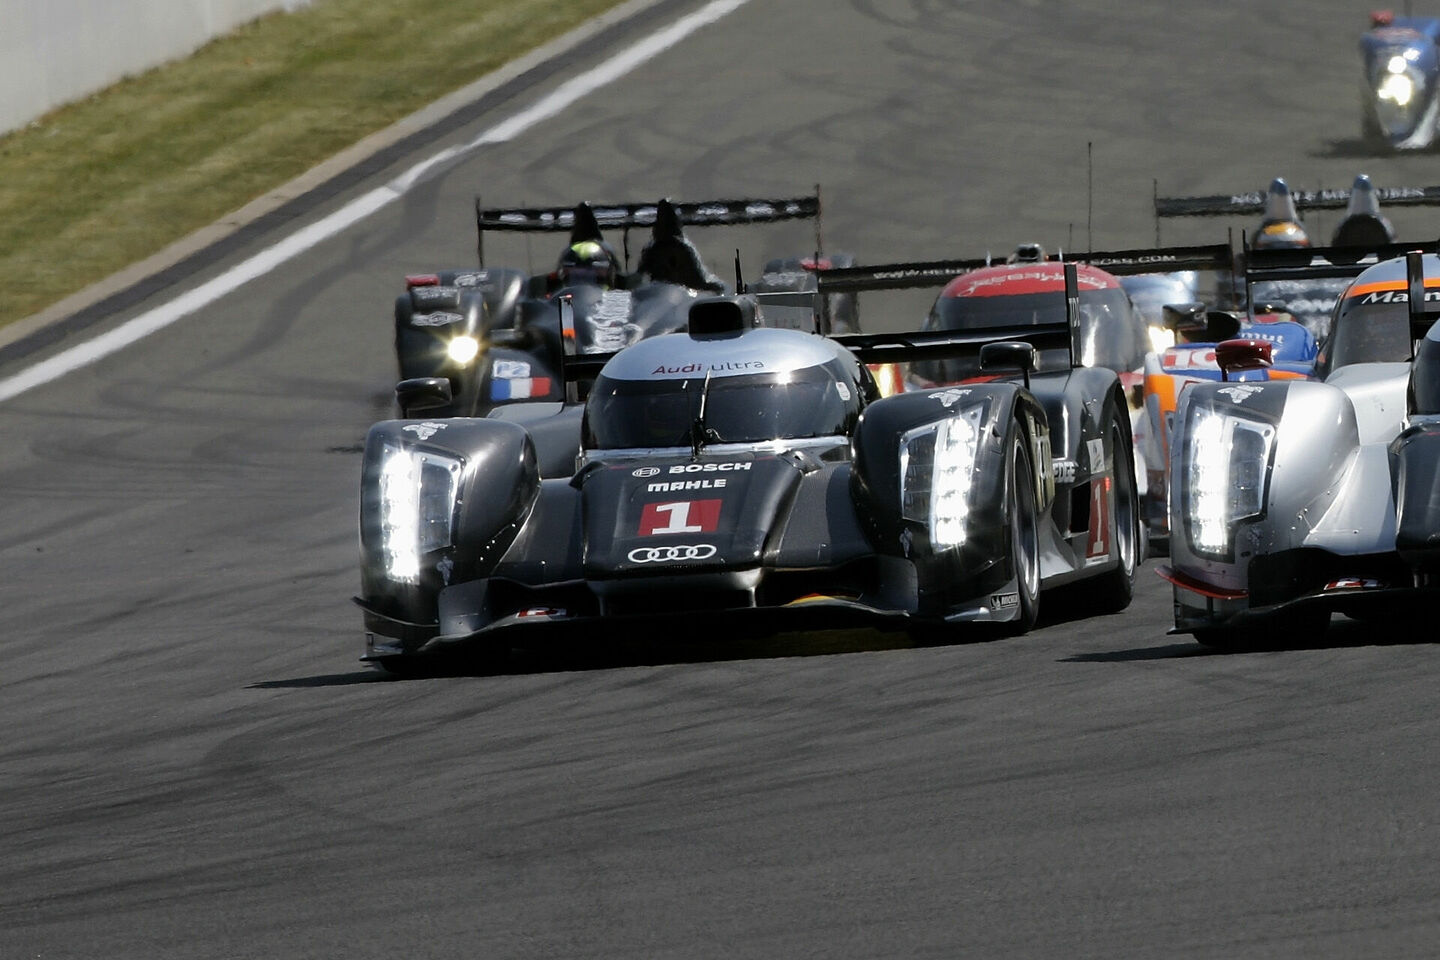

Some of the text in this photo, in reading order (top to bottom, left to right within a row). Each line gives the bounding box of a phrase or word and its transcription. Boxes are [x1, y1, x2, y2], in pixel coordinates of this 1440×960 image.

[652, 360, 765, 375] Audi ultra
[668, 462, 753, 475] BOSCH
[647, 479, 728, 493] MAHLE
[651, 501, 703, 535] 1
[1092, 483, 1104, 555] 1
